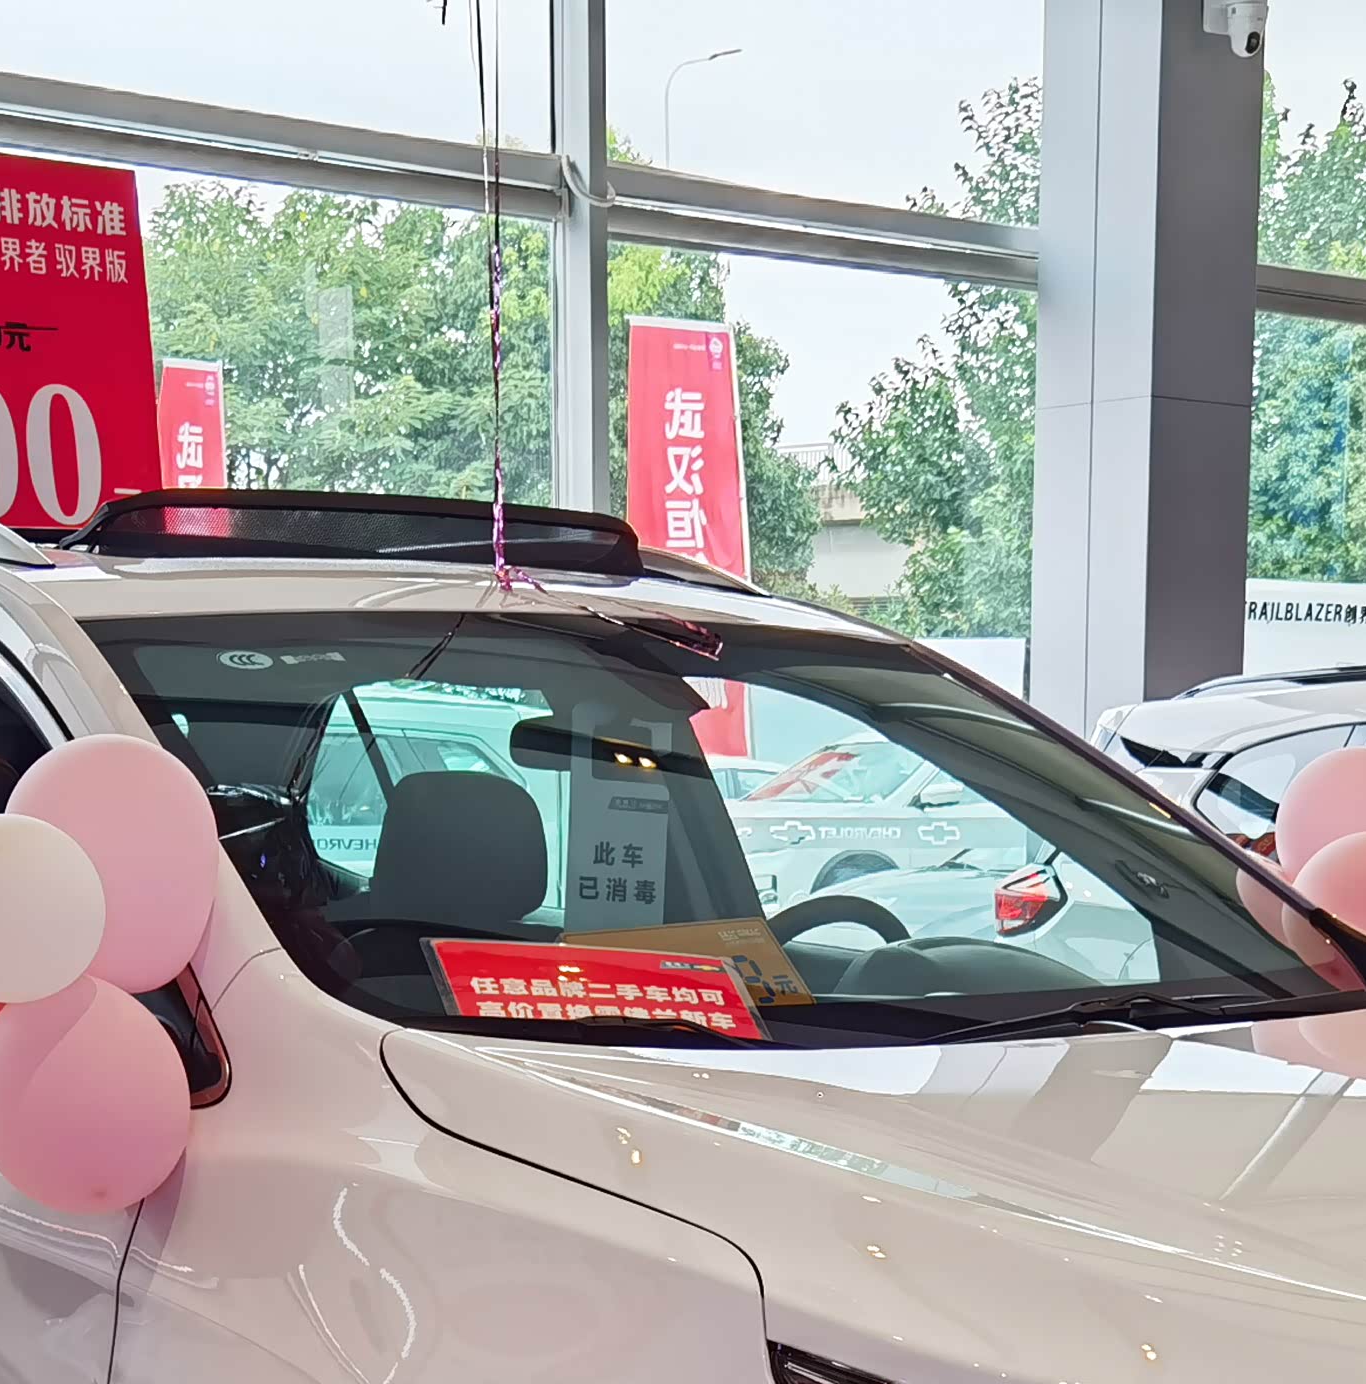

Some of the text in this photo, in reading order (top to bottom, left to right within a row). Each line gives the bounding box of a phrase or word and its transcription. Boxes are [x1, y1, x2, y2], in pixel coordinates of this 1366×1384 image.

[55, 240, 129, 285] 驭界版
[593, 841, 644, 868] 此车
[578, 876, 657, 905] 已消毒
[470, 977, 724, 1006] 任意品牌二手车均可
